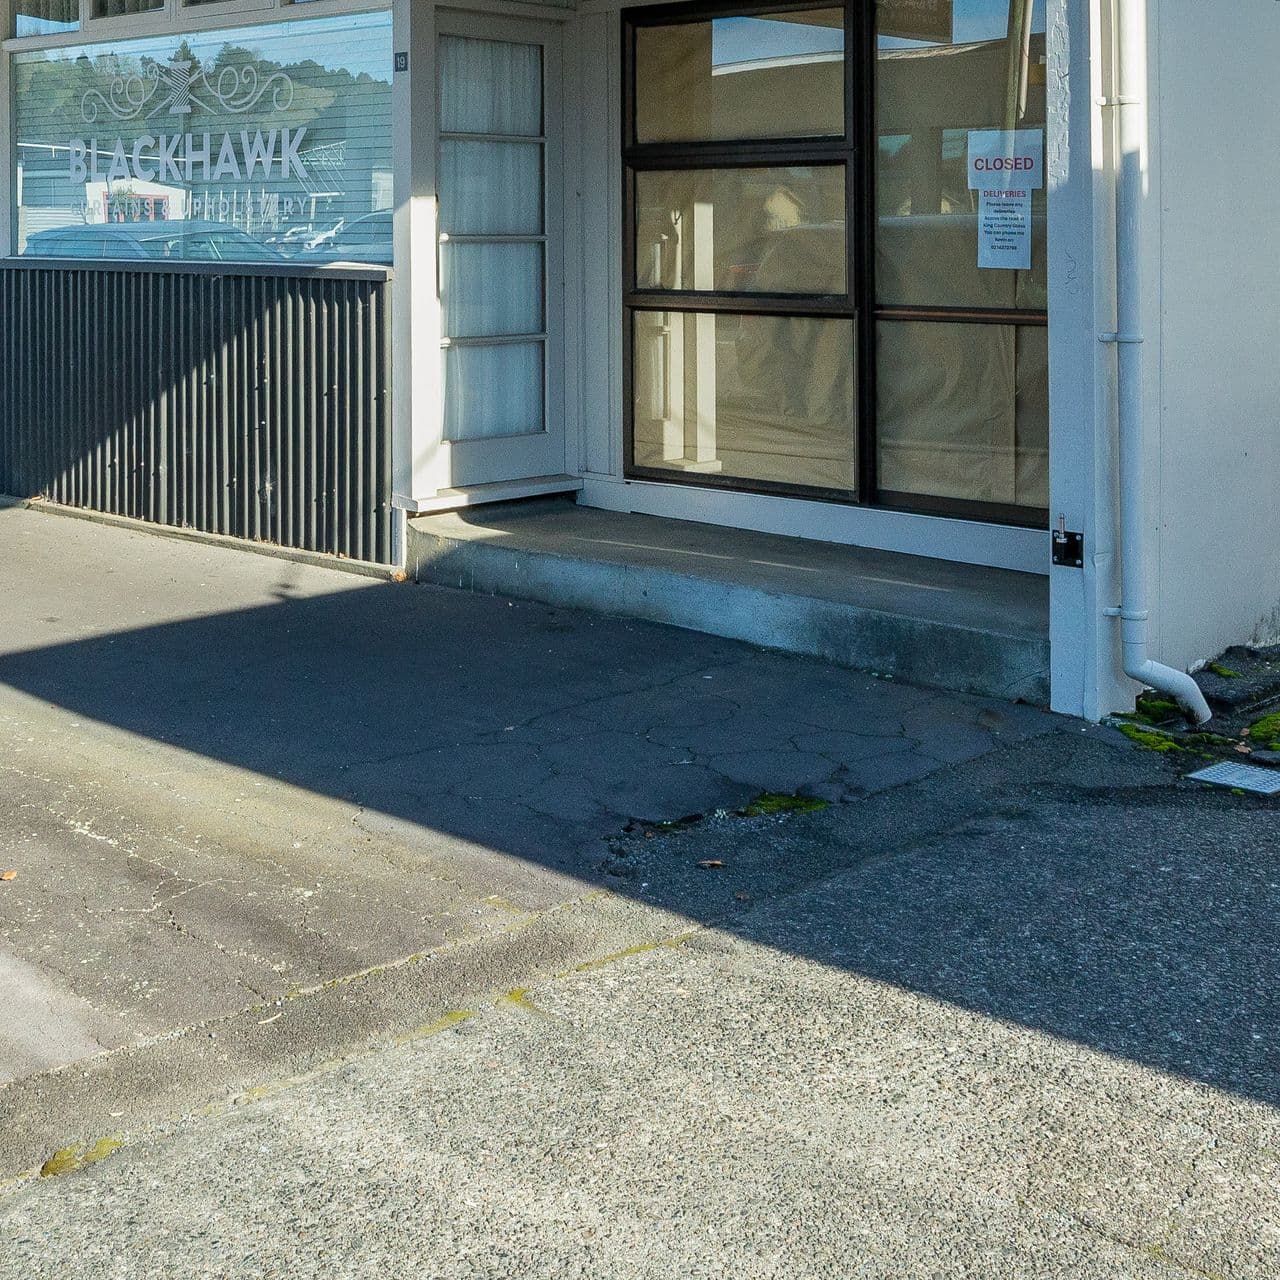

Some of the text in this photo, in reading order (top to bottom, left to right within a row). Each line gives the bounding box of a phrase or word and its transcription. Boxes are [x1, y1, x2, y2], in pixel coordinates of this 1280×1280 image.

[397, 56, 406, 68] 19
[70, 127, 309, 184] BLACKHAWK
[974, 158, 1034, 170] CLOSED
[983, 190, 1026, 198] DELIVERIES
